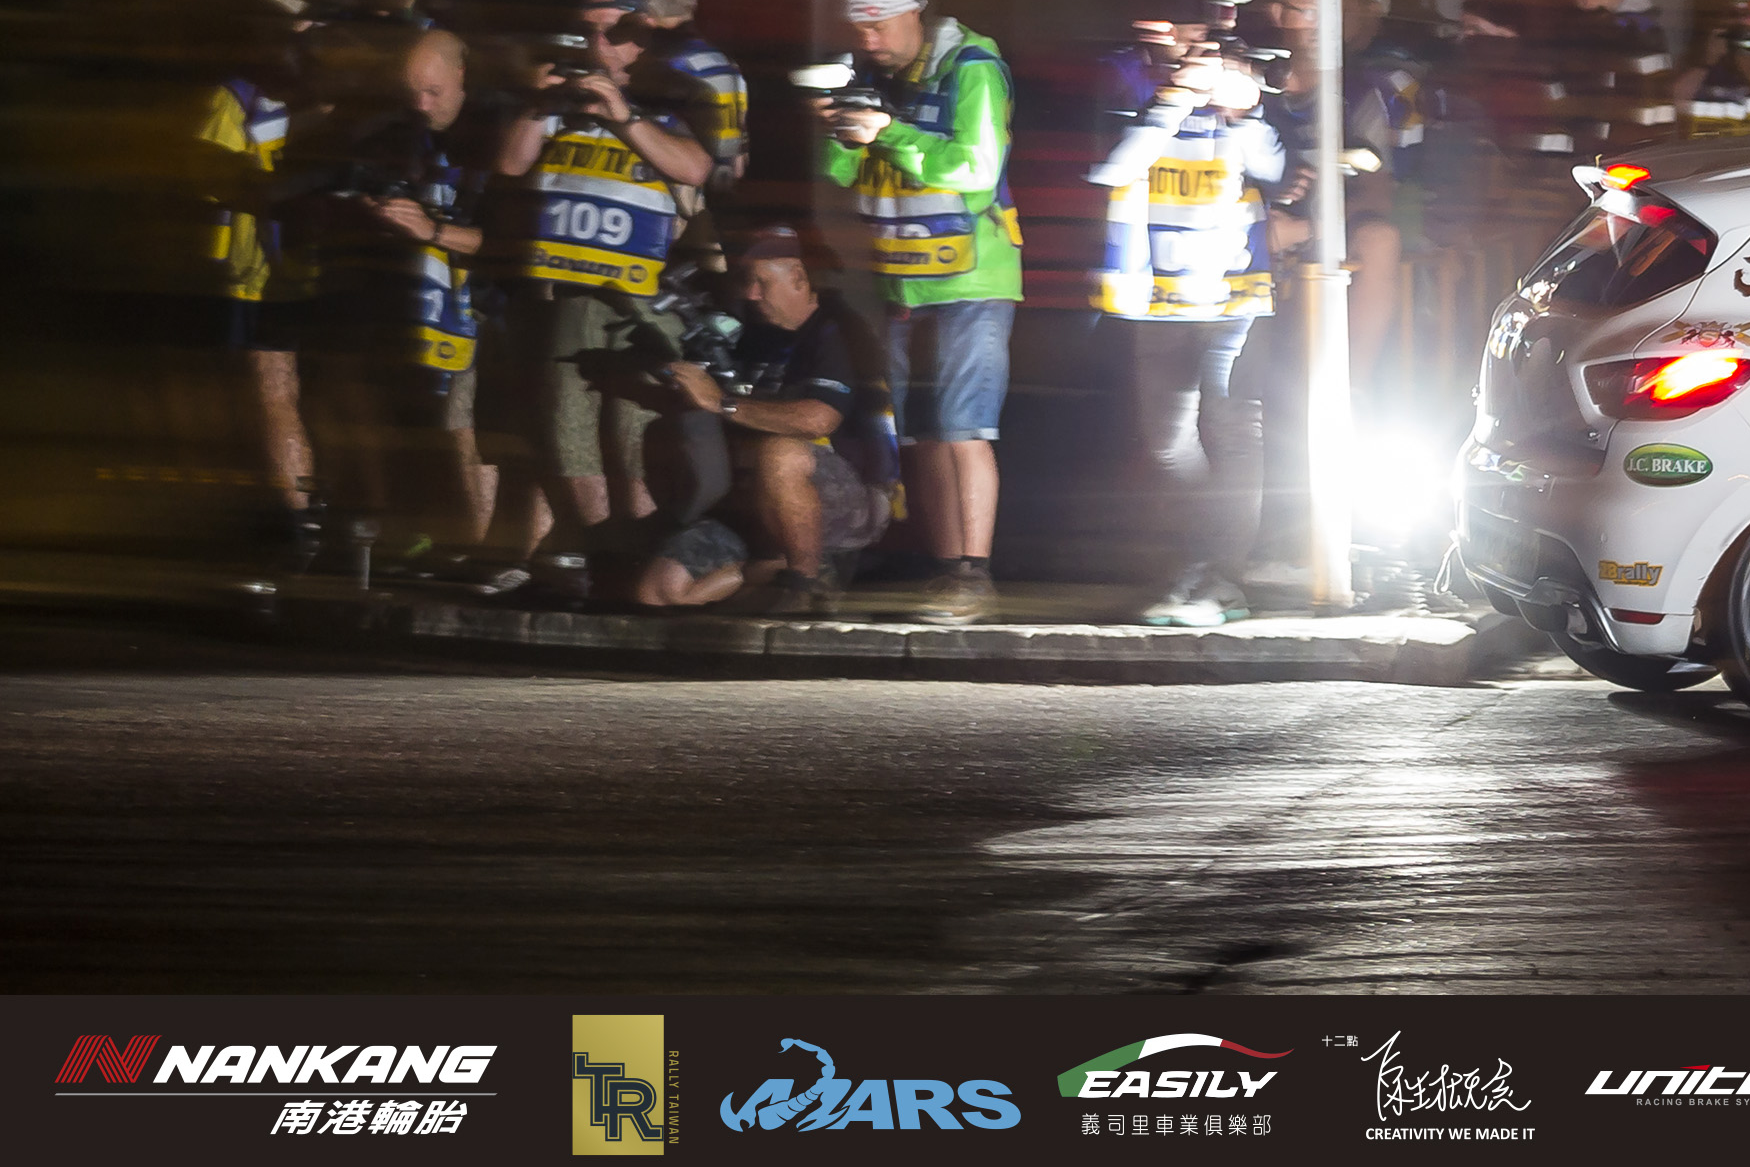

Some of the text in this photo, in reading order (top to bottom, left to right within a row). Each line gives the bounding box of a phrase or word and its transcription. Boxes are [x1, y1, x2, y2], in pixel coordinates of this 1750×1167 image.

[549, 199, 633, 246] 109
[1626, 457, 1708, 474] J.C. BRAKE
